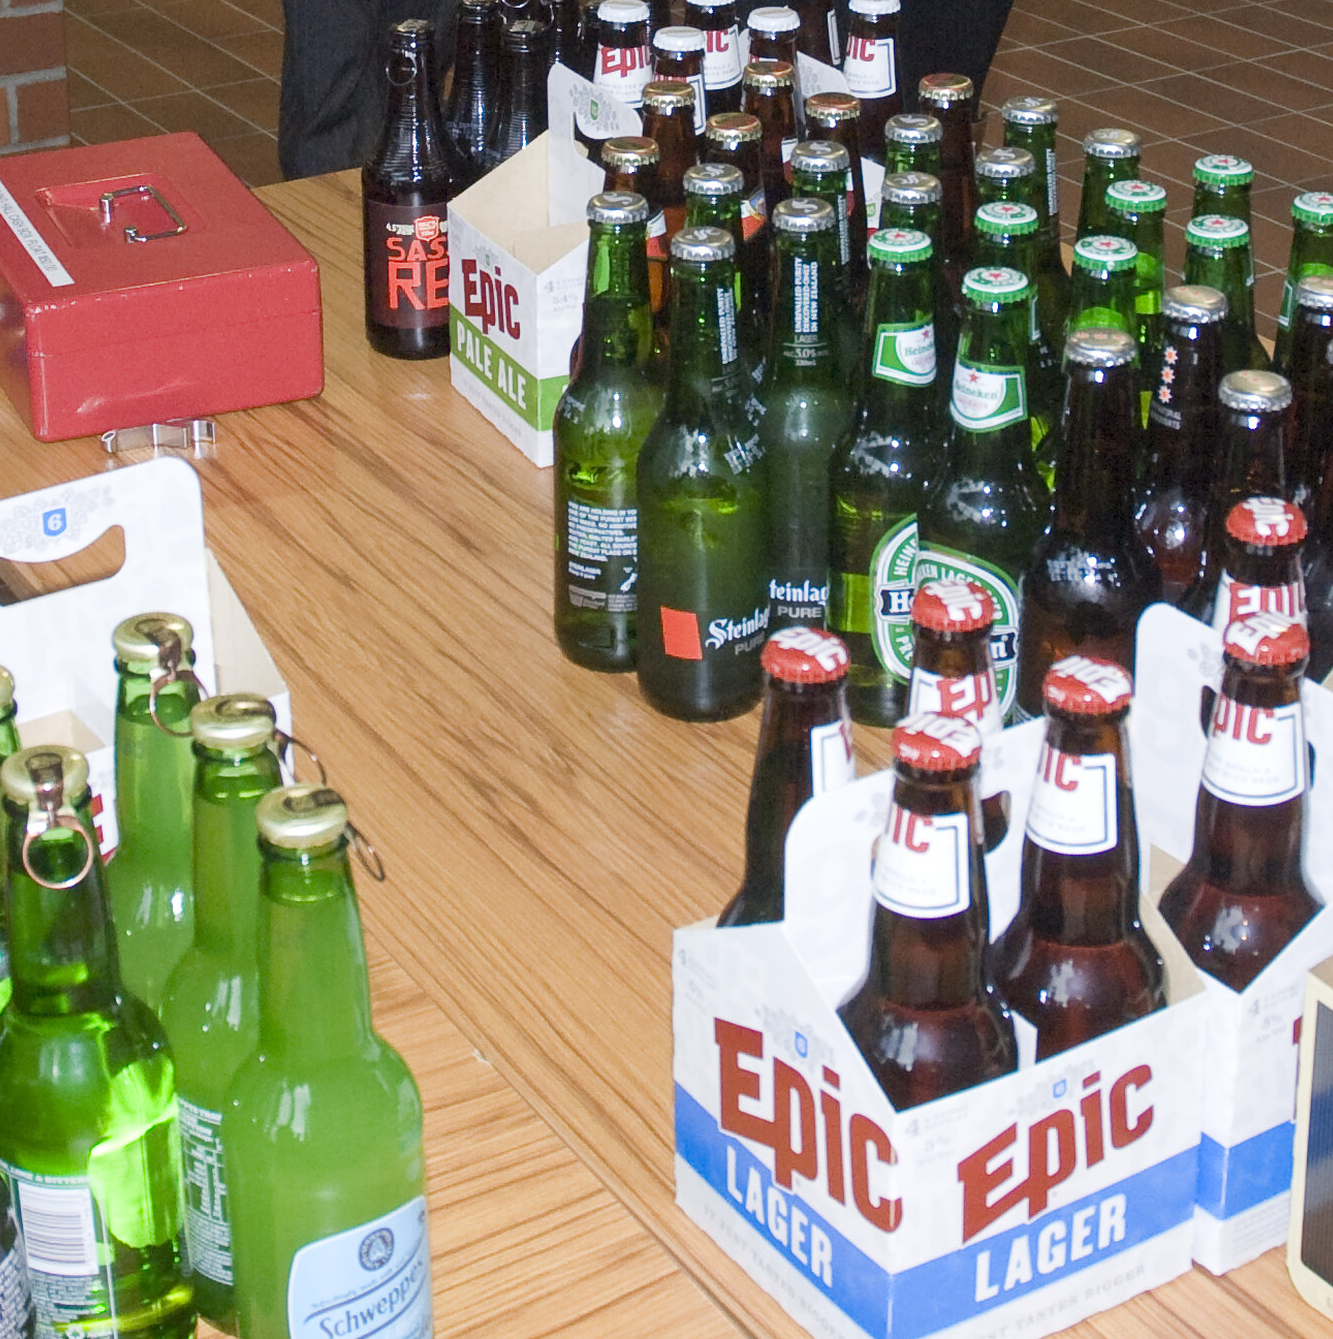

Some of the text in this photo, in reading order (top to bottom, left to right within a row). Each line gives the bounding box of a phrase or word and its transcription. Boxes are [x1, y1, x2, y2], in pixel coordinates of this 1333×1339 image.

[461, 259, 521, 341] Epic
[794, 335, 818, 343] LAGER
[457, 320, 527, 410] PALE ALE
[46, 513, 63, 531] 6
[768, 626, 848, 672] Epic
[777, 605, 822, 619] PURE
[714, 1017, 903, 1234] Epic
[957, 1064, 1155, 1245] Epic
[725, 1145, 833, 1288] LAGER
[974, 1193, 1128, 1304] LAGER
